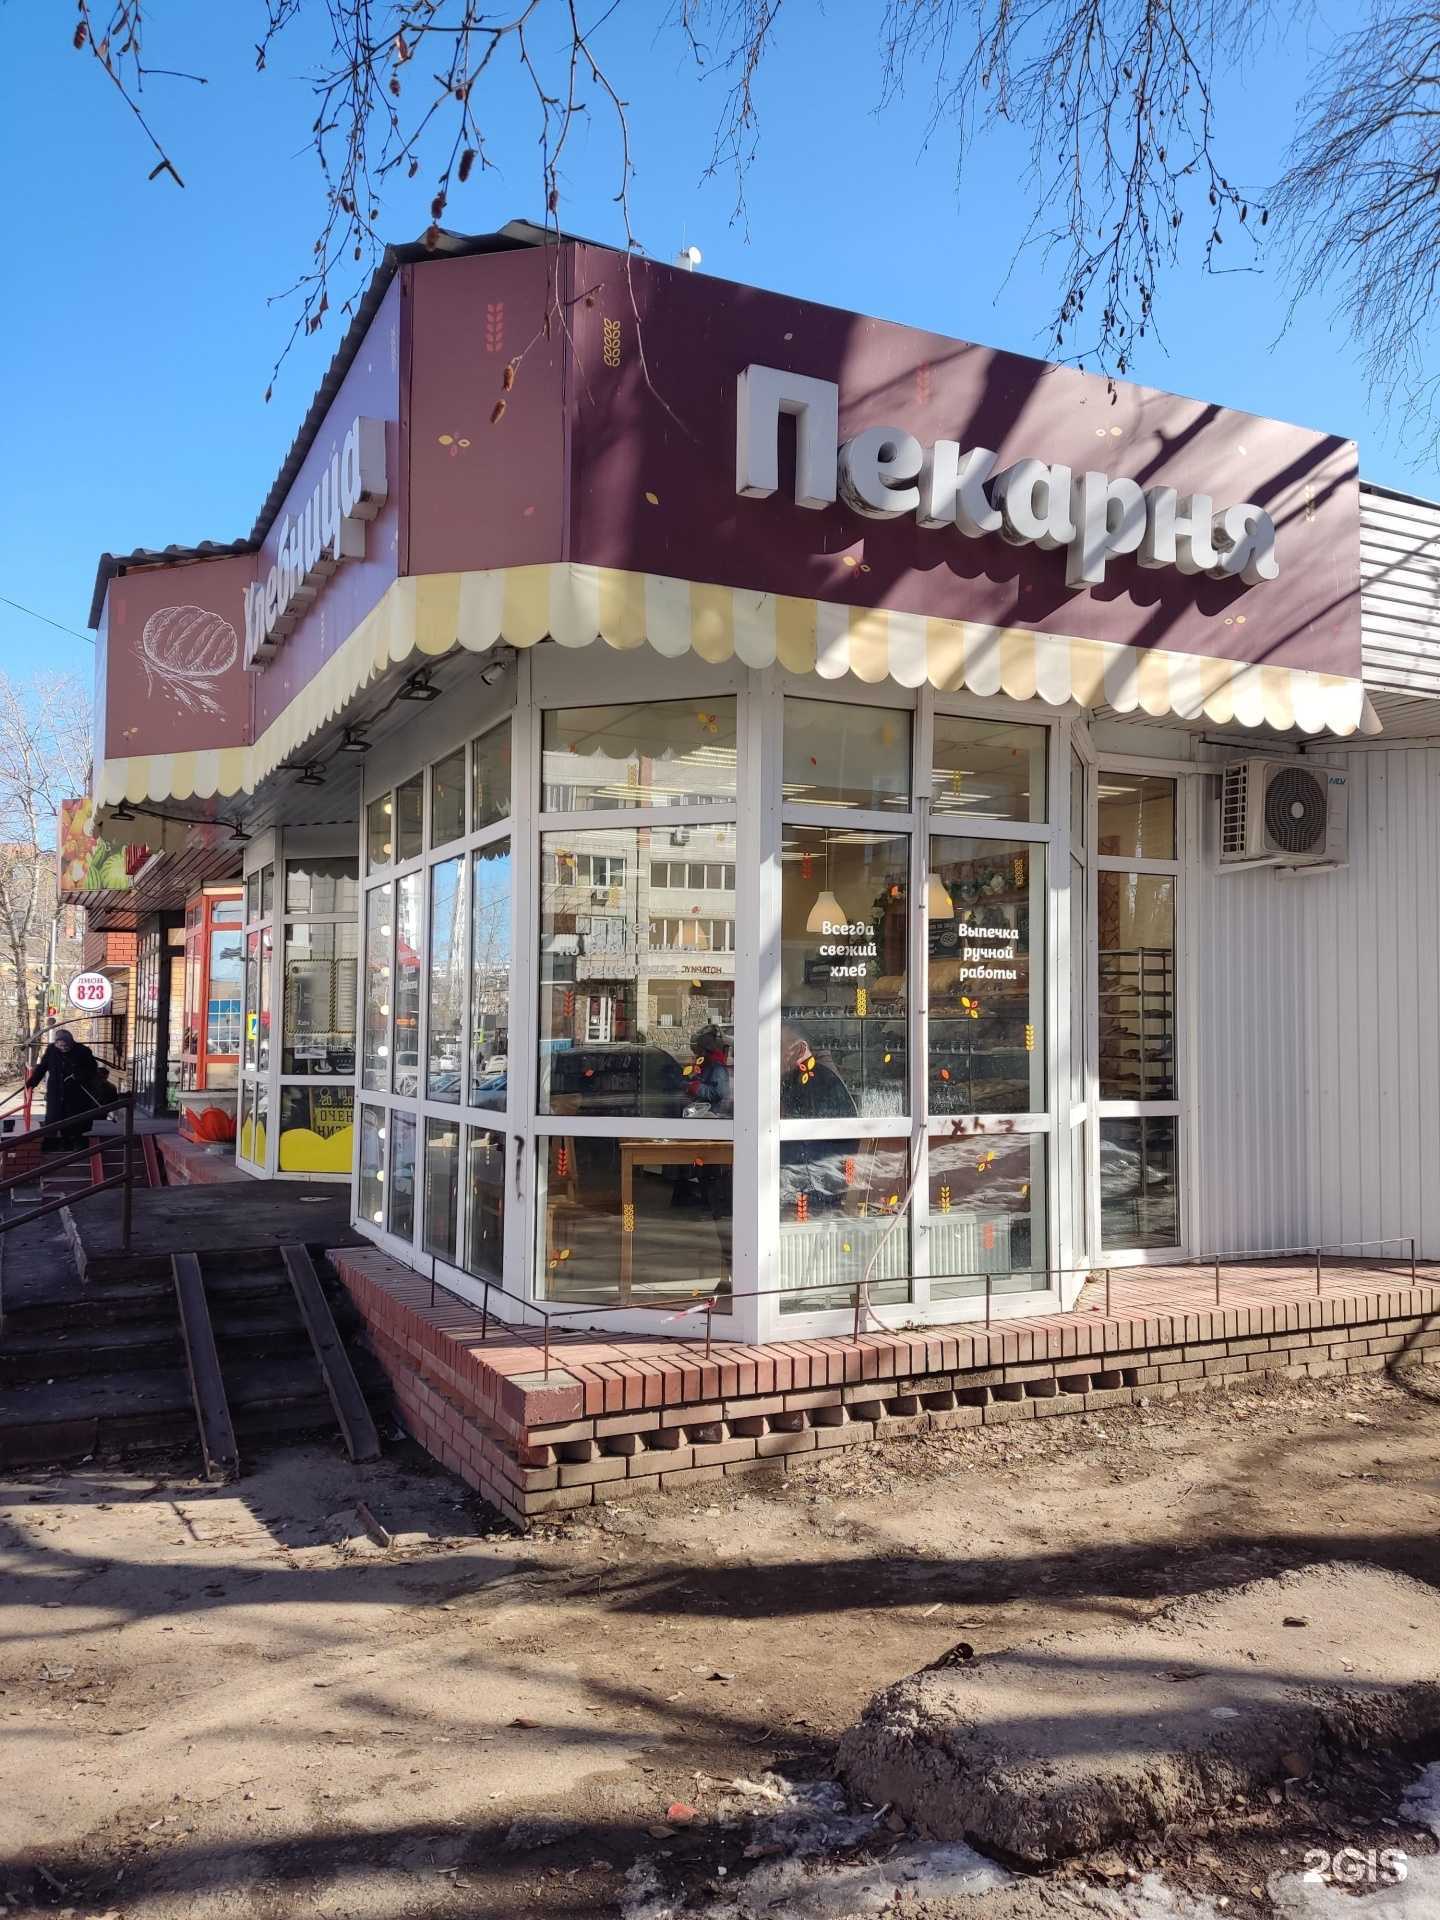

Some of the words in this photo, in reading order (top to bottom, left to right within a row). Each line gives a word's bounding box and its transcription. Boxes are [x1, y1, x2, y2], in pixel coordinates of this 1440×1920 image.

[736, 363, 1280, 590] Пекарня
[820, 920, 875, 937] Всегда
[958, 923, 1019, 940] Выпечка
[819, 942, 877, 957] свежий
[963, 943, 1014, 961] ручной
[830, 962, 867, 977] хлеб
[959, 964, 1017, 982] работы
[320, 1110, 353, 1122] ОЧЕН
